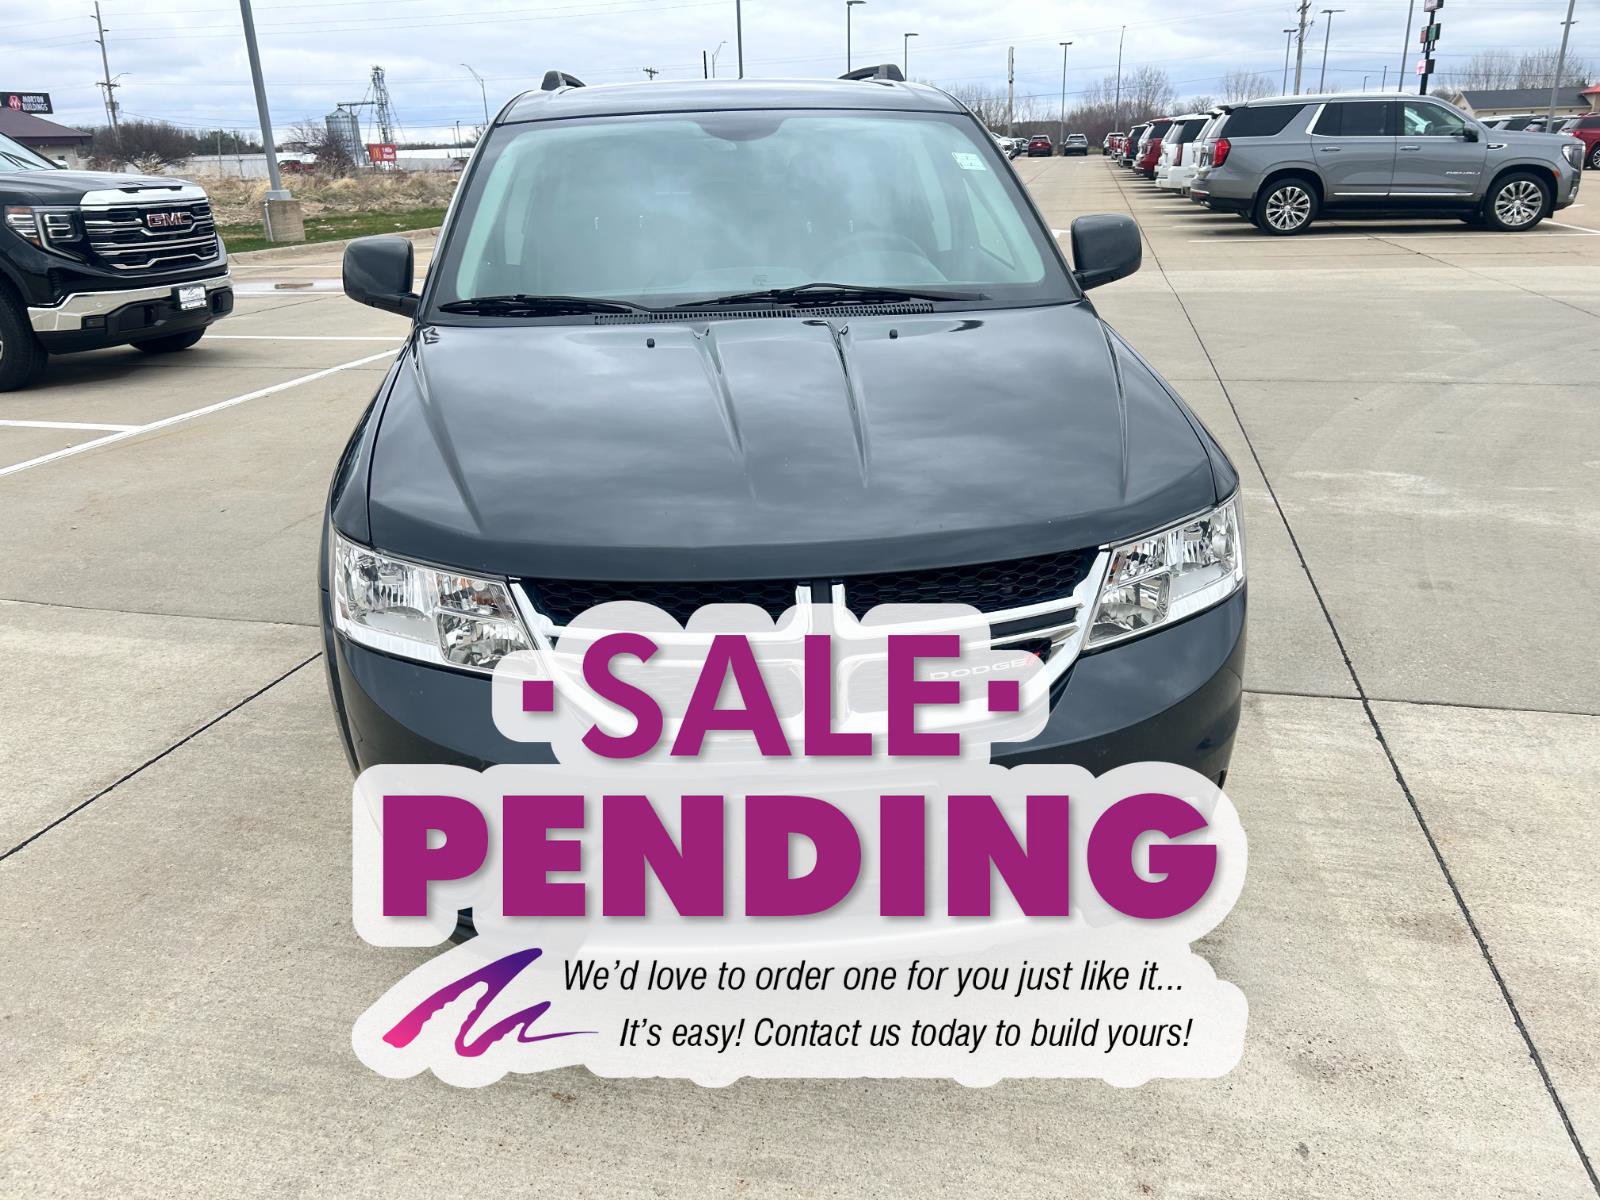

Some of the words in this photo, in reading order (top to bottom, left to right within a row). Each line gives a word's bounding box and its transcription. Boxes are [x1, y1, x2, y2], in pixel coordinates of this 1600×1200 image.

[22, 95, 44, 103] MORTON
[146, 211, 193, 227] GMC
[929, 656, 1026, 680] DODGE
